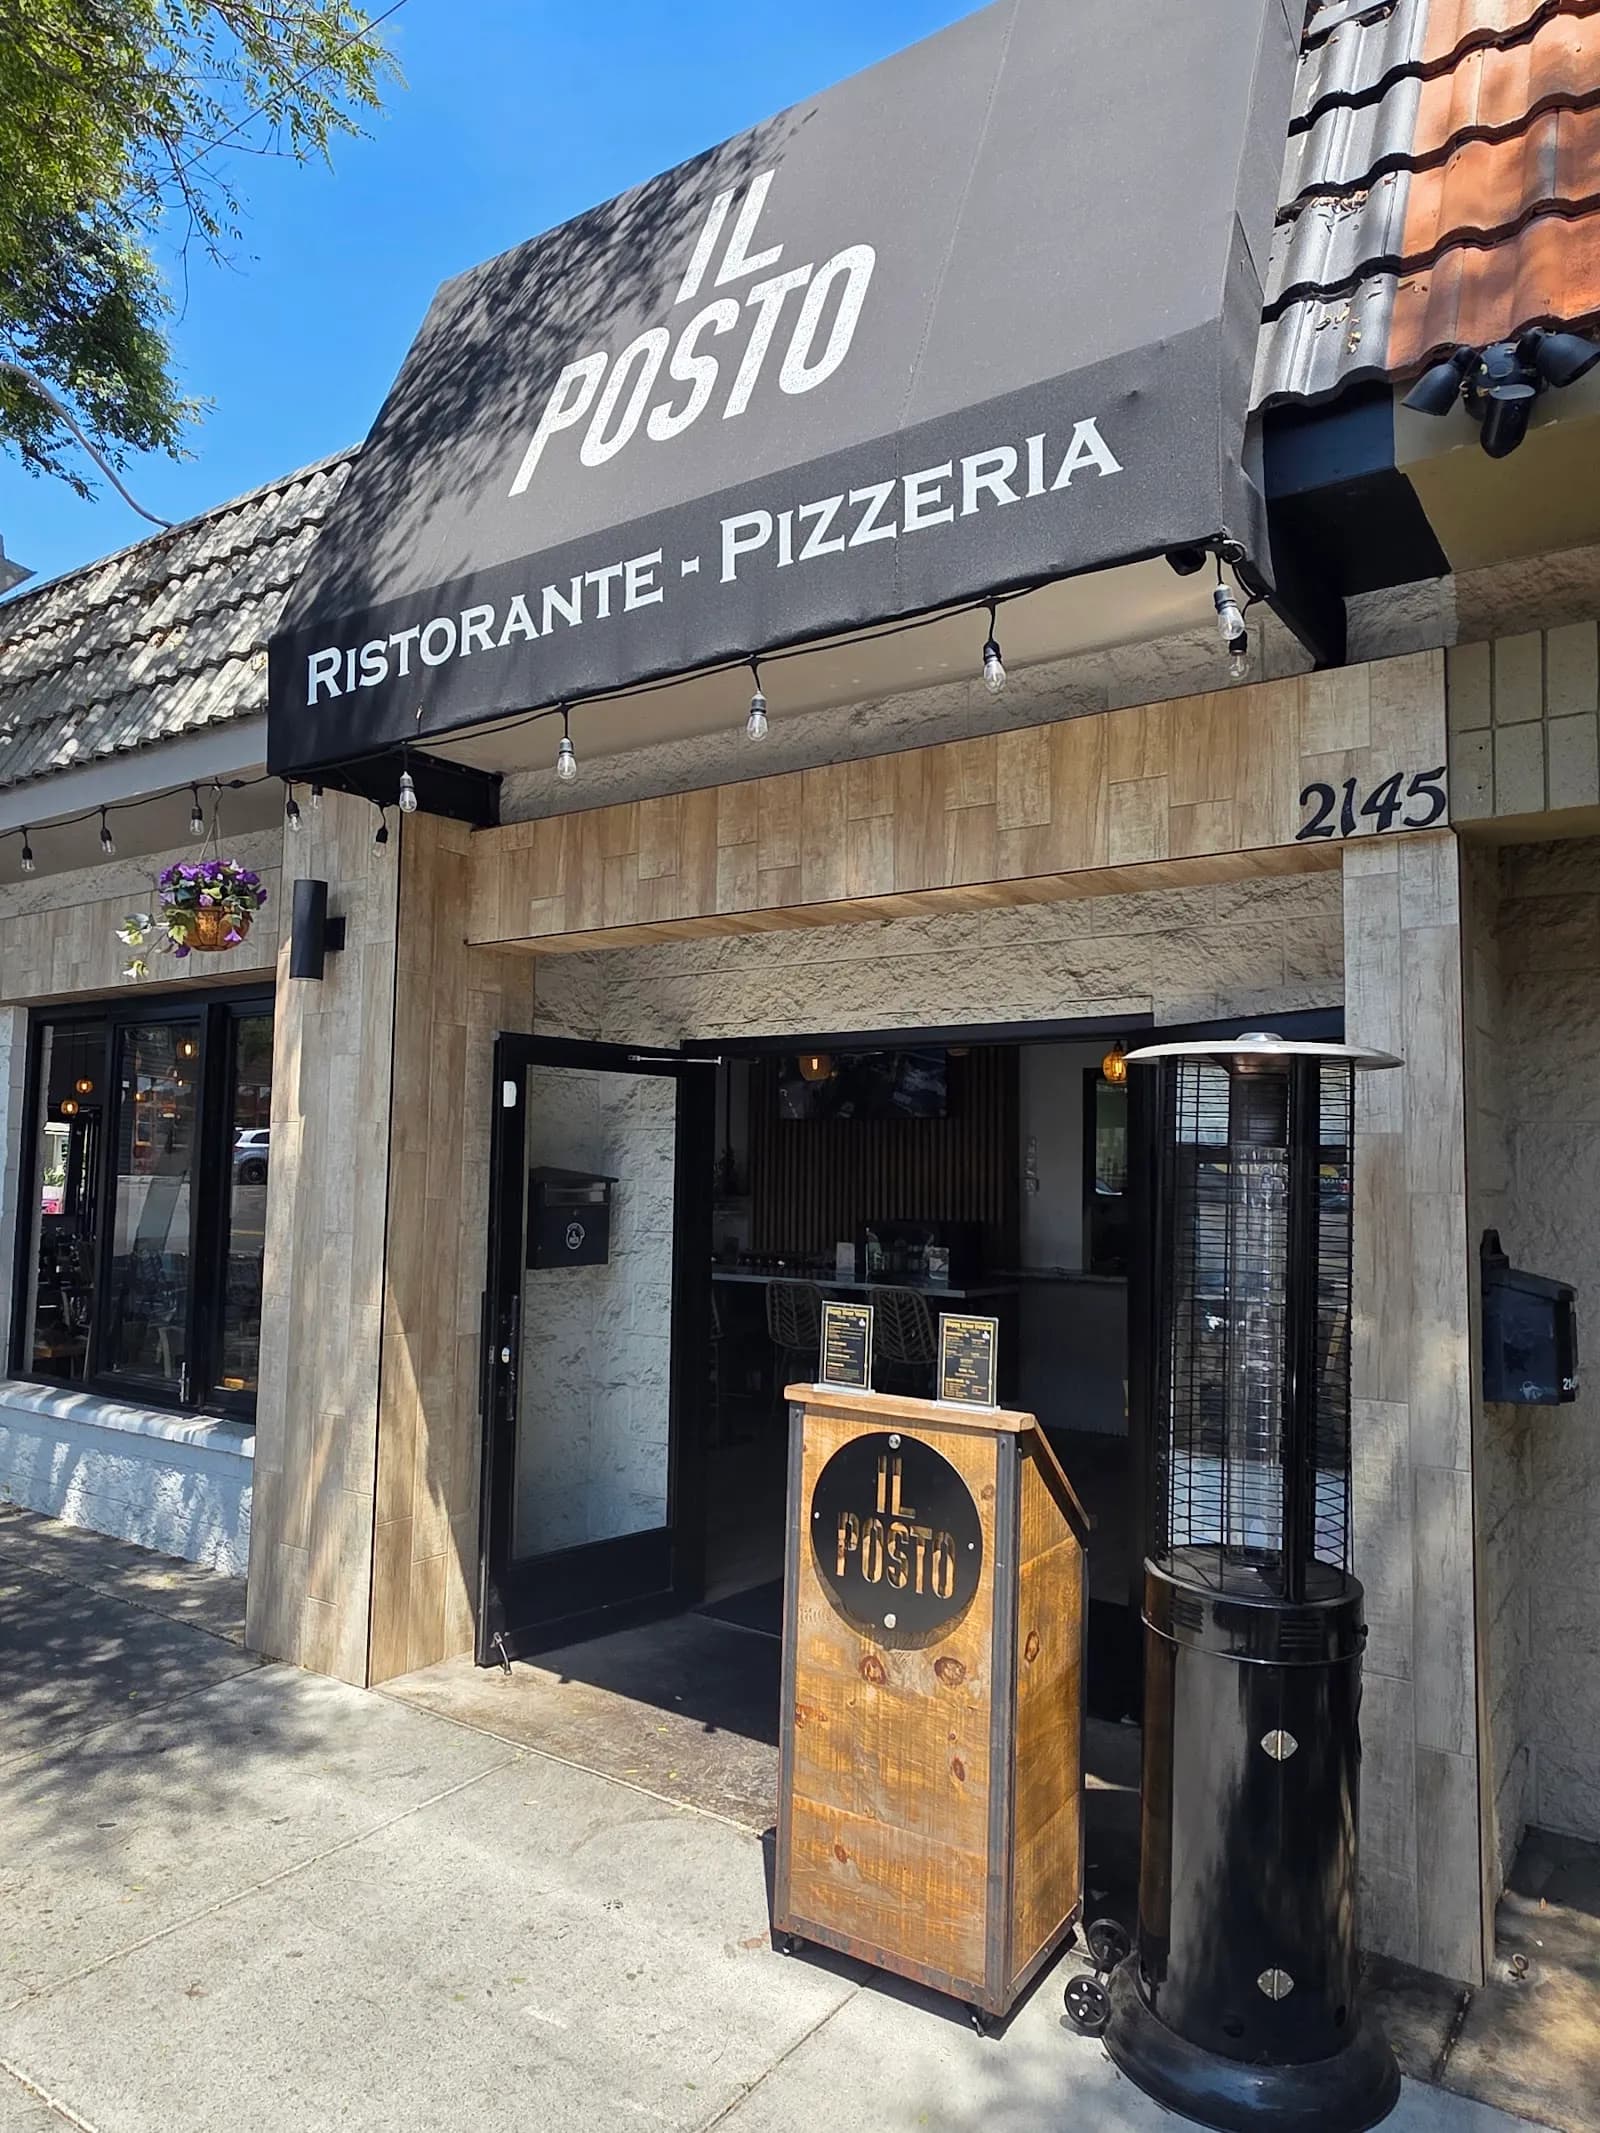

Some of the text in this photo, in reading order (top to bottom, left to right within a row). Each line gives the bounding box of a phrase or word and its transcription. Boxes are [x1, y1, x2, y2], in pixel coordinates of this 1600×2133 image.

[674, 169, 784, 305] IL
[508, 243, 876, 498] POSTO
[306, 547, 664, 706] RISTORANTE
[720, 416, 1124, 583] PIZZERIA
[1295, 766, 1447, 840] 2145
[876, 1455, 916, 1519] IL
[836, 1511, 956, 1599] POSTO
